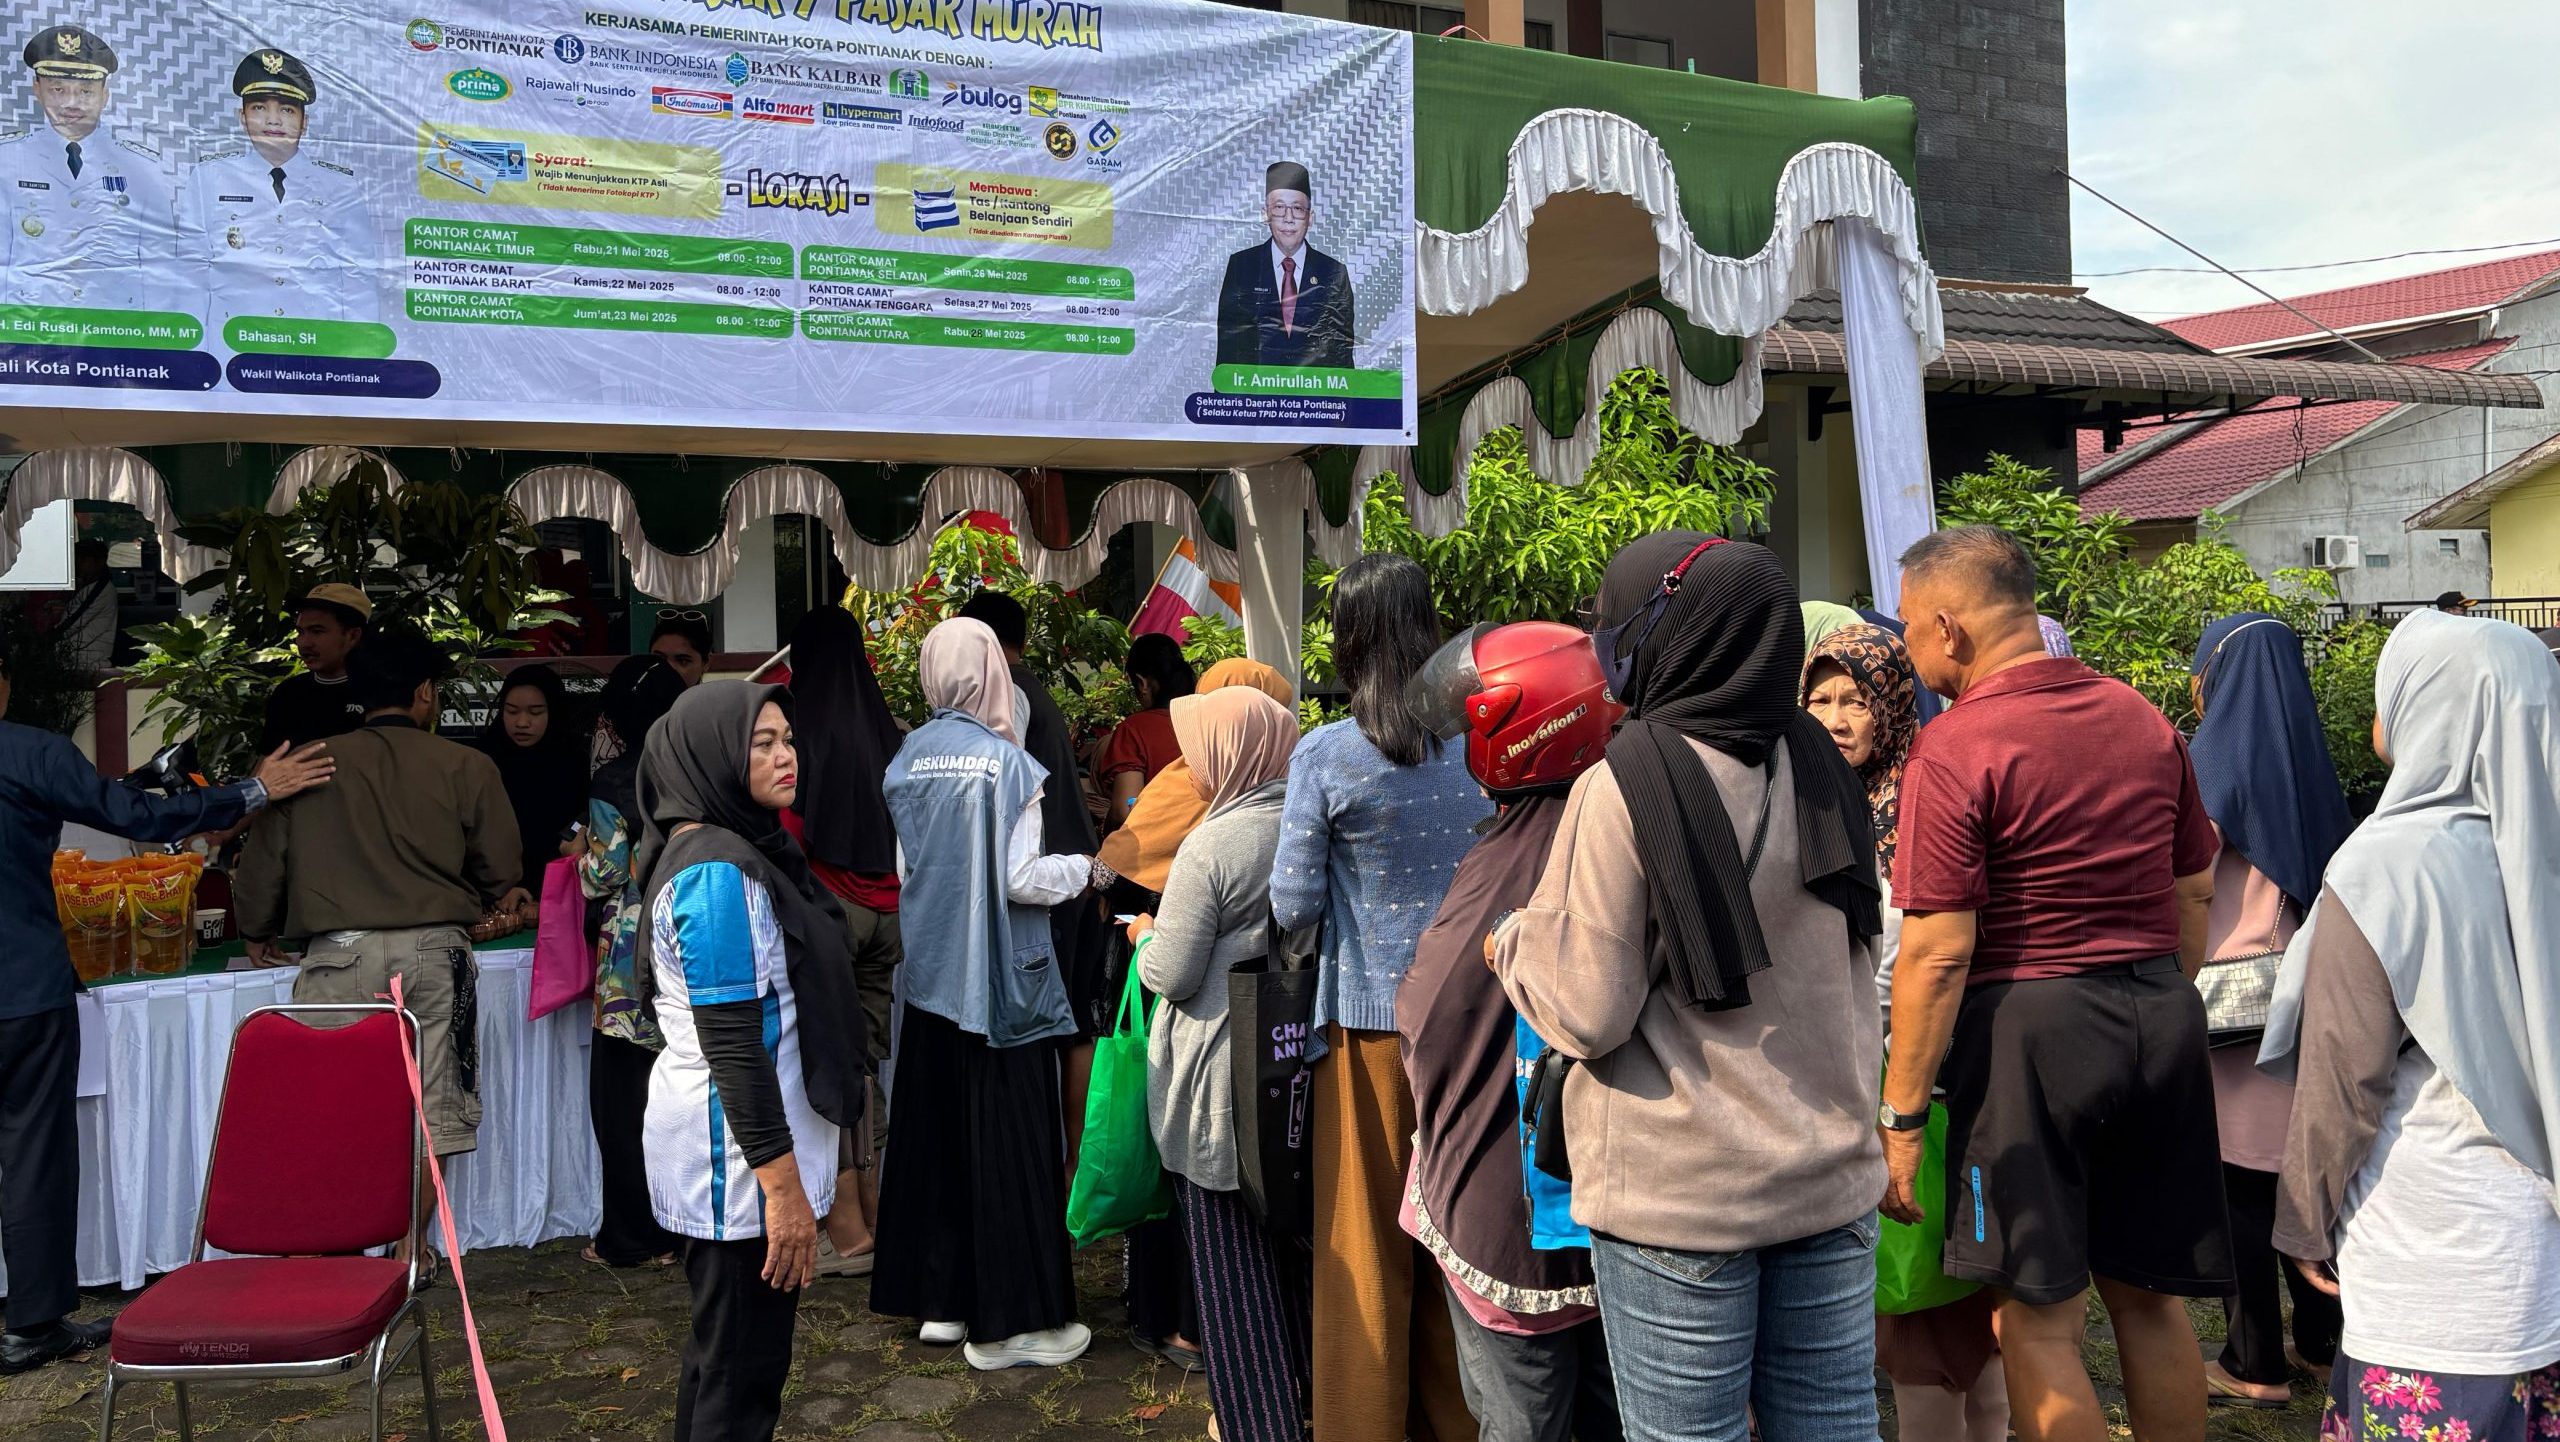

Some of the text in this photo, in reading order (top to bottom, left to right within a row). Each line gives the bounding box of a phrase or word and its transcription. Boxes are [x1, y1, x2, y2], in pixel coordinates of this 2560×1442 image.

[971, 0, 1102, 52] MURAH
[445, 26, 545, 45] PEMERINTAHAN KOTA
[585, 12, 985, 68] KERJASAMA PEMERINTAH KOTA PONTIANAK DENGAN
[446, 36, 544, 59] PONTIANAK
[590, 46, 718, 70] BANK INDONESIA
[612, 64, 642, 72] SENTRAL
[644, 66, 677, 76] REPUBLIK
[679, 70, 718, 79] INDONESIA
[752, 62, 882, 88] BANK KALBAR
[458, 79, 500, 92] prima
[526, 77, 636, 98] Rajawali Nusindo
[667, 96, 718, 110] Indomaret
[961, 84, 1022, 114] bulog
[1058, 92, 1090, 102] Perusahaan
[742, 97, 814, 116] Alfamart
[840, 104, 900, 120] hypermart
[1059, 110, 1087, 119] Pontianak
[822, 118, 837, 126] Low
[840, 120, 860, 128] prices
[908, 114, 964, 132] Indofood
[534, 152, 586, 168] Syarat
[1086, 156, 1122, 168] GARAM
[534, 169, 668, 188] Wajib Menunjukkan KTP Asli
[543, 184, 564, 192] Tidak
[566, 186, 605, 195] Menerima
[606, 188, 640, 198] Fotokopi
[970, 182, 1032, 196] Membawa
[970, 196, 990, 207] Tas
[970, 210, 1072, 228] Belanjaan Sendiri
[414, 225, 518, 242] KANTOR CAMAT
[414, 239, 535, 256] PONTIANAK TIMUR
[574, 244, 782, 266] Rabu,21 Mei 2025 08.00 12:00
[414, 260, 514, 276] KANTOR CAMAT
[809, 252, 898, 268] KANTOR CAMAT
[414, 274, 532, 289] PONTIANAK BARAT
[810, 265, 928, 282] PONTIANAK SELATAN
[988, 270, 1004, 279] Mei
[1006, 271, 1028, 281] 2025
[1066, 276, 1090, 284] 08.00
[1098, 278, 1120, 286] 12:00
[574, 277, 780, 298] Kamis,22 Mei 2025 08.00 12:00
[810, 284, 894, 298] KANTOR CAMAT
[414, 293, 513, 306] KANTOR CAMAT
[810, 296, 934, 312] PONTIANAK TENGGARA
[944, 298, 1120, 316] Selasa,27 Mei 2025 08.00 12:00
[414, 306, 524, 320] PONTIANAK KOTA
[574, 309, 780, 328] Jum'at,23 Mei 2025 08.00 12:00
[810, 314, 894, 327] KANTOR CAMAT
[14, 320, 36, 331] Edi
[40, 322, 78, 334] Rusdi
[82, 324, 144, 338] Kamtono,
[149, 326, 174, 338] MM,
[179, 328, 198, 338] MT
[238, 330, 316, 344] Bahasan, SH
[810, 326, 910, 340] PONTIANAK UTARA
[985, 330, 1000, 338] Mei
[1004, 330, 1026, 340] 2025
[1066, 334, 1090, 342] 08.00
[1098, 336, 1120, 344] 12:00
[0, 360, 170, 378] ali Kota Pontianak
[241, 369, 380, 384] Wakil Walikota Pontianak
[1233, 372, 1348, 390] Ir. Amirullah MA
[1196, 397, 1346, 410] Sekretaris Daerah Kota Pontianak
[1202, 408, 1340, 420] Selaku Ketua TPID Kota Pontianak
[911, 756, 1000, 774] DISKUMDAG
[82, 890, 114, 906] BRAND
[134, 888, 158, 900] ROSE
[1272, 1022, 1308, 1041] CHA
